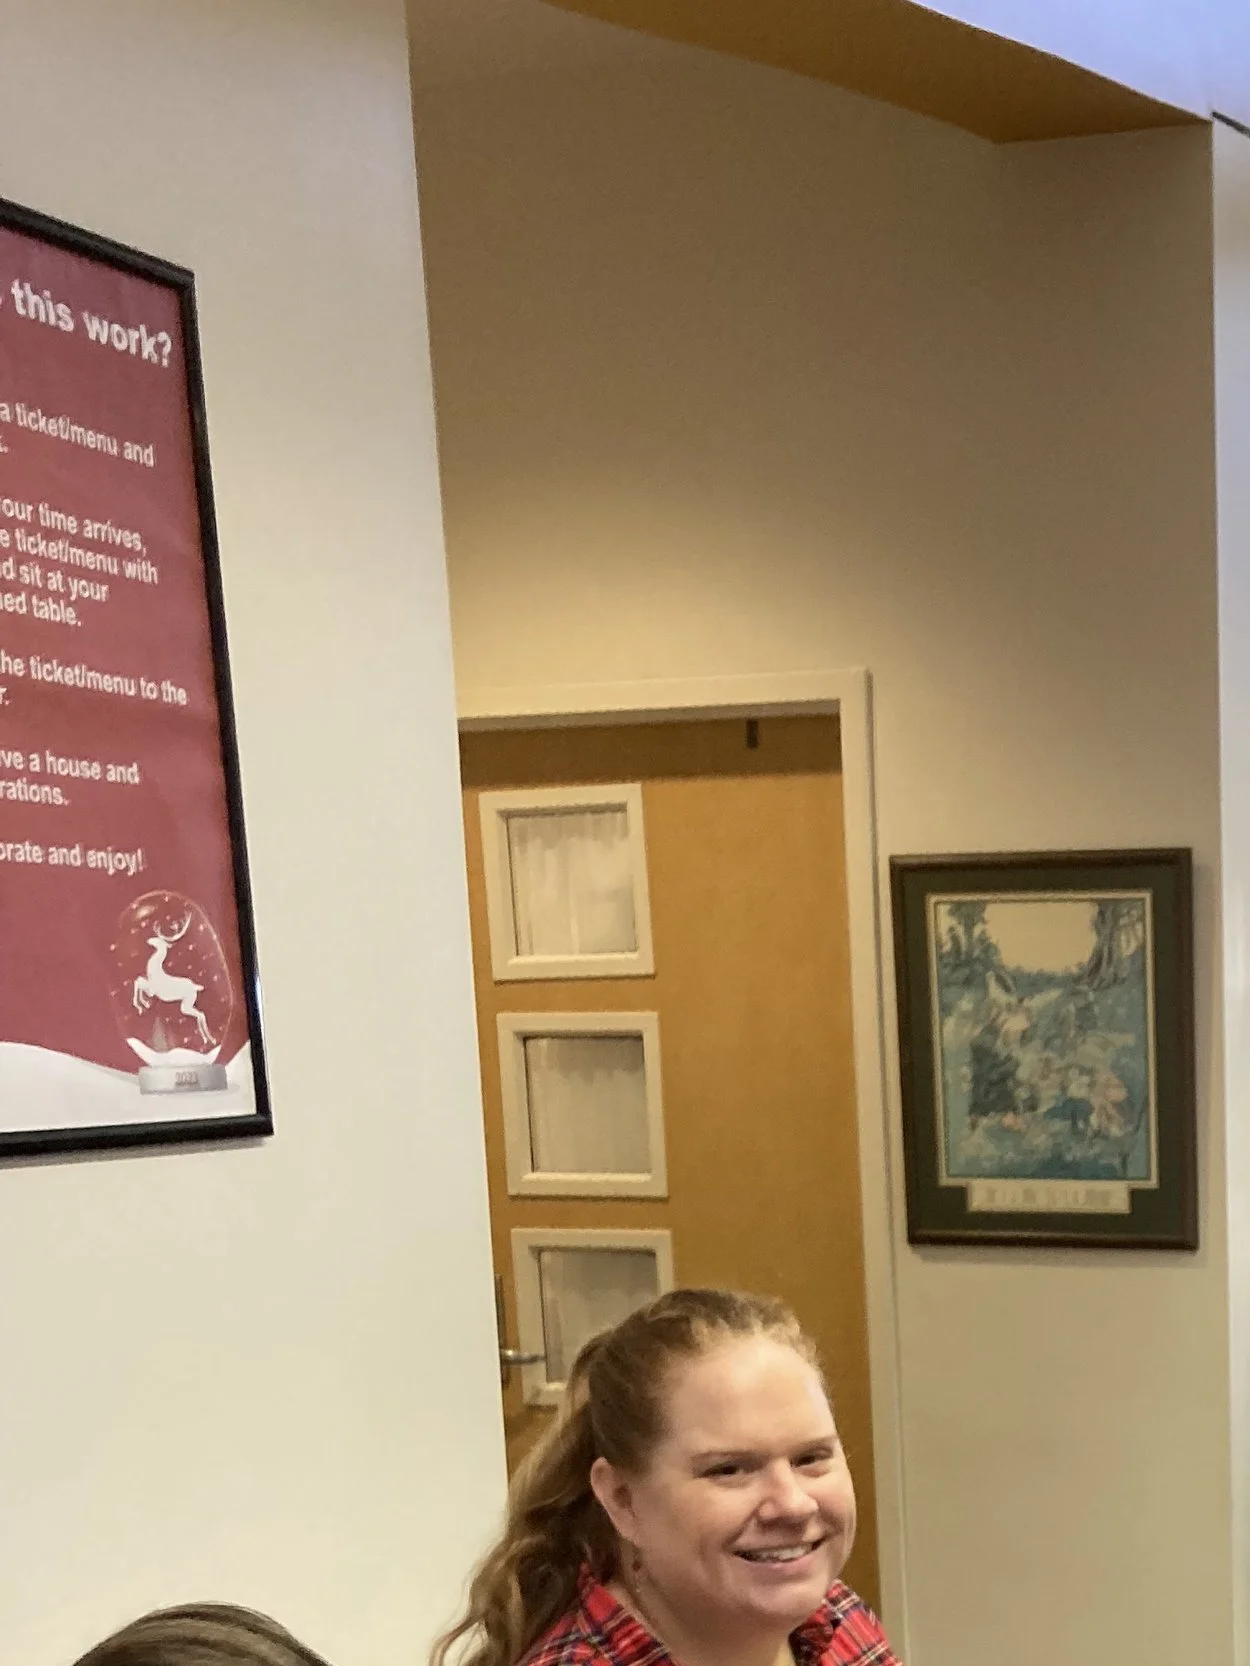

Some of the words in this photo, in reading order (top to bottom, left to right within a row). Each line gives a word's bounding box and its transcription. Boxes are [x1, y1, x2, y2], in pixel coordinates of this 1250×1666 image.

[11, 278, 74, 332] this
[82, 311, 172, 368] work?
[15, 402, 118, 456] ticket/menu
[124, 440, 155, 468] and
[38, 502, 77, 534] time
[83, 518, 147, 557] arrives,
[16, 528, 118, 575] ticket/menu
[123, 560, 158, 585] with
[20, 562, 42, 588] sit
[47, 570, 65, 592] at
[68, 577, 109, 602] your
[32, 597, 81, 627] table.
[30, 656, 136, 696] ticket/menu
[141, 678, 158, 700] to
[162, 680, 187, 706] the
[30, 753, 40, 772] a
[46, 751, 100, 780] house
[107, 763, 140, 785] and
[49, 845, 81, 868] and
[87, 849, 142, 875] enjoy!
